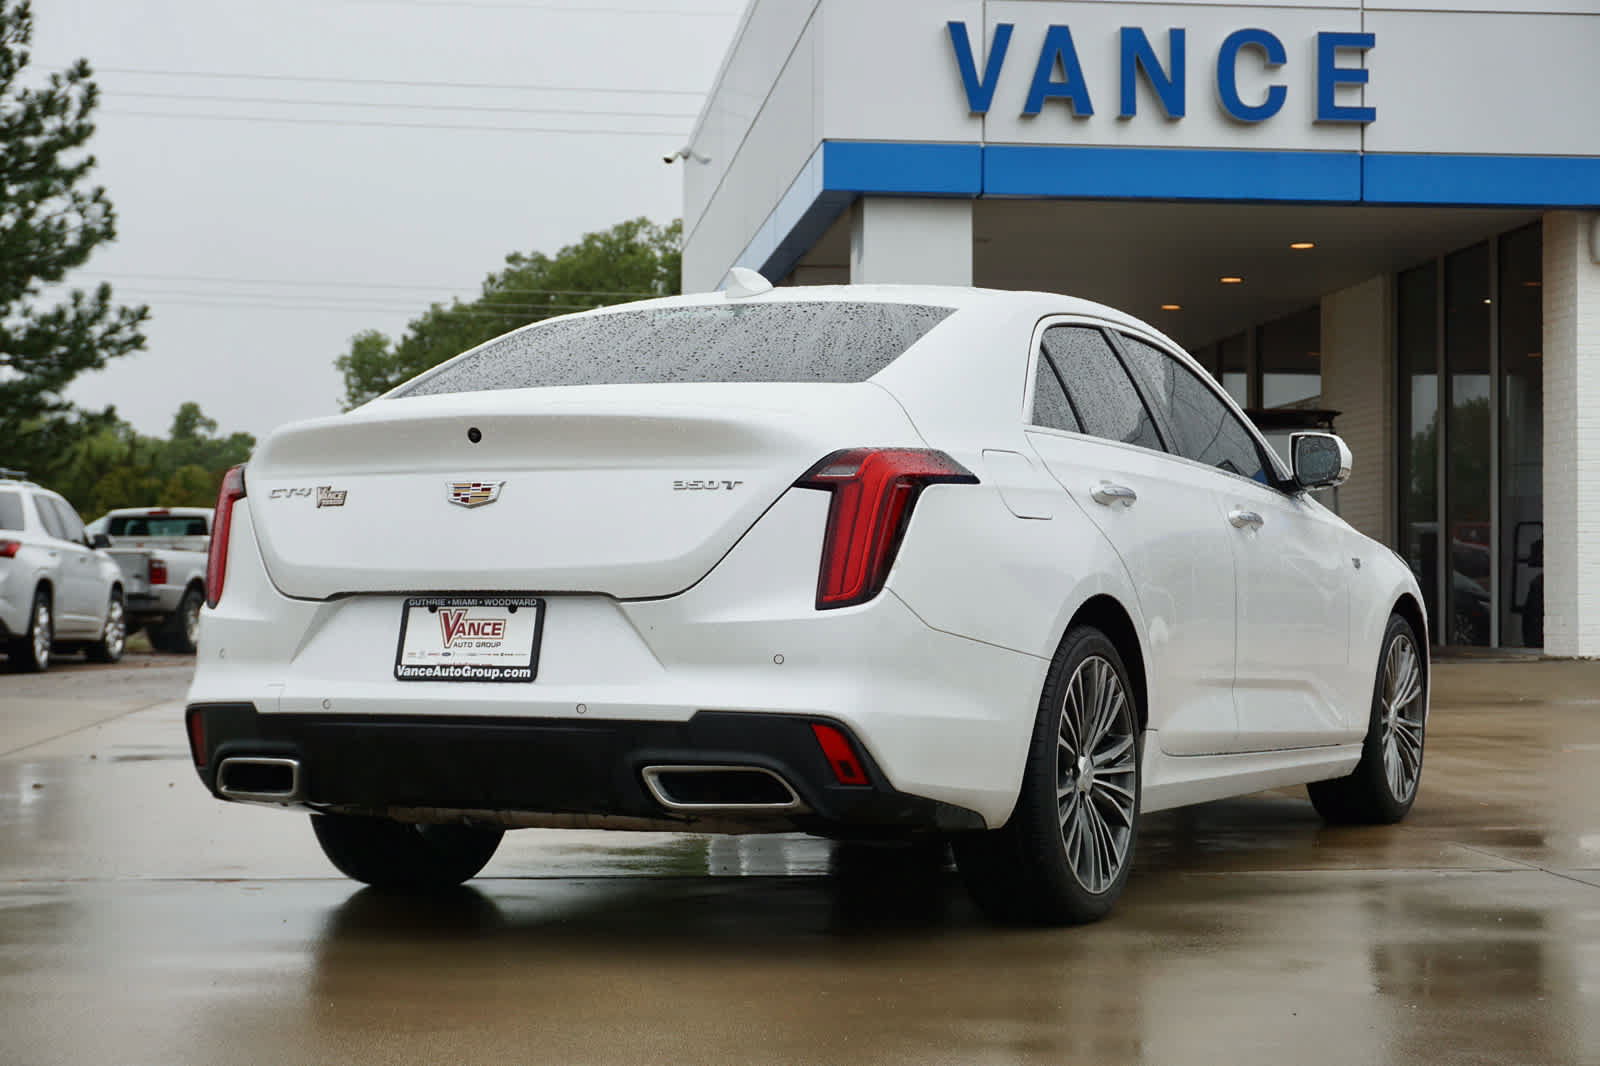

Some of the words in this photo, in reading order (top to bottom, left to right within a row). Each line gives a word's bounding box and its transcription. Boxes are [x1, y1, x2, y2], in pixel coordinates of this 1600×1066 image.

[946, 21, 1376, 125] VANCE
[441, 610, 504, 646] VANCE
[397, 665, 532, 679] VanceAutoGroup.com
